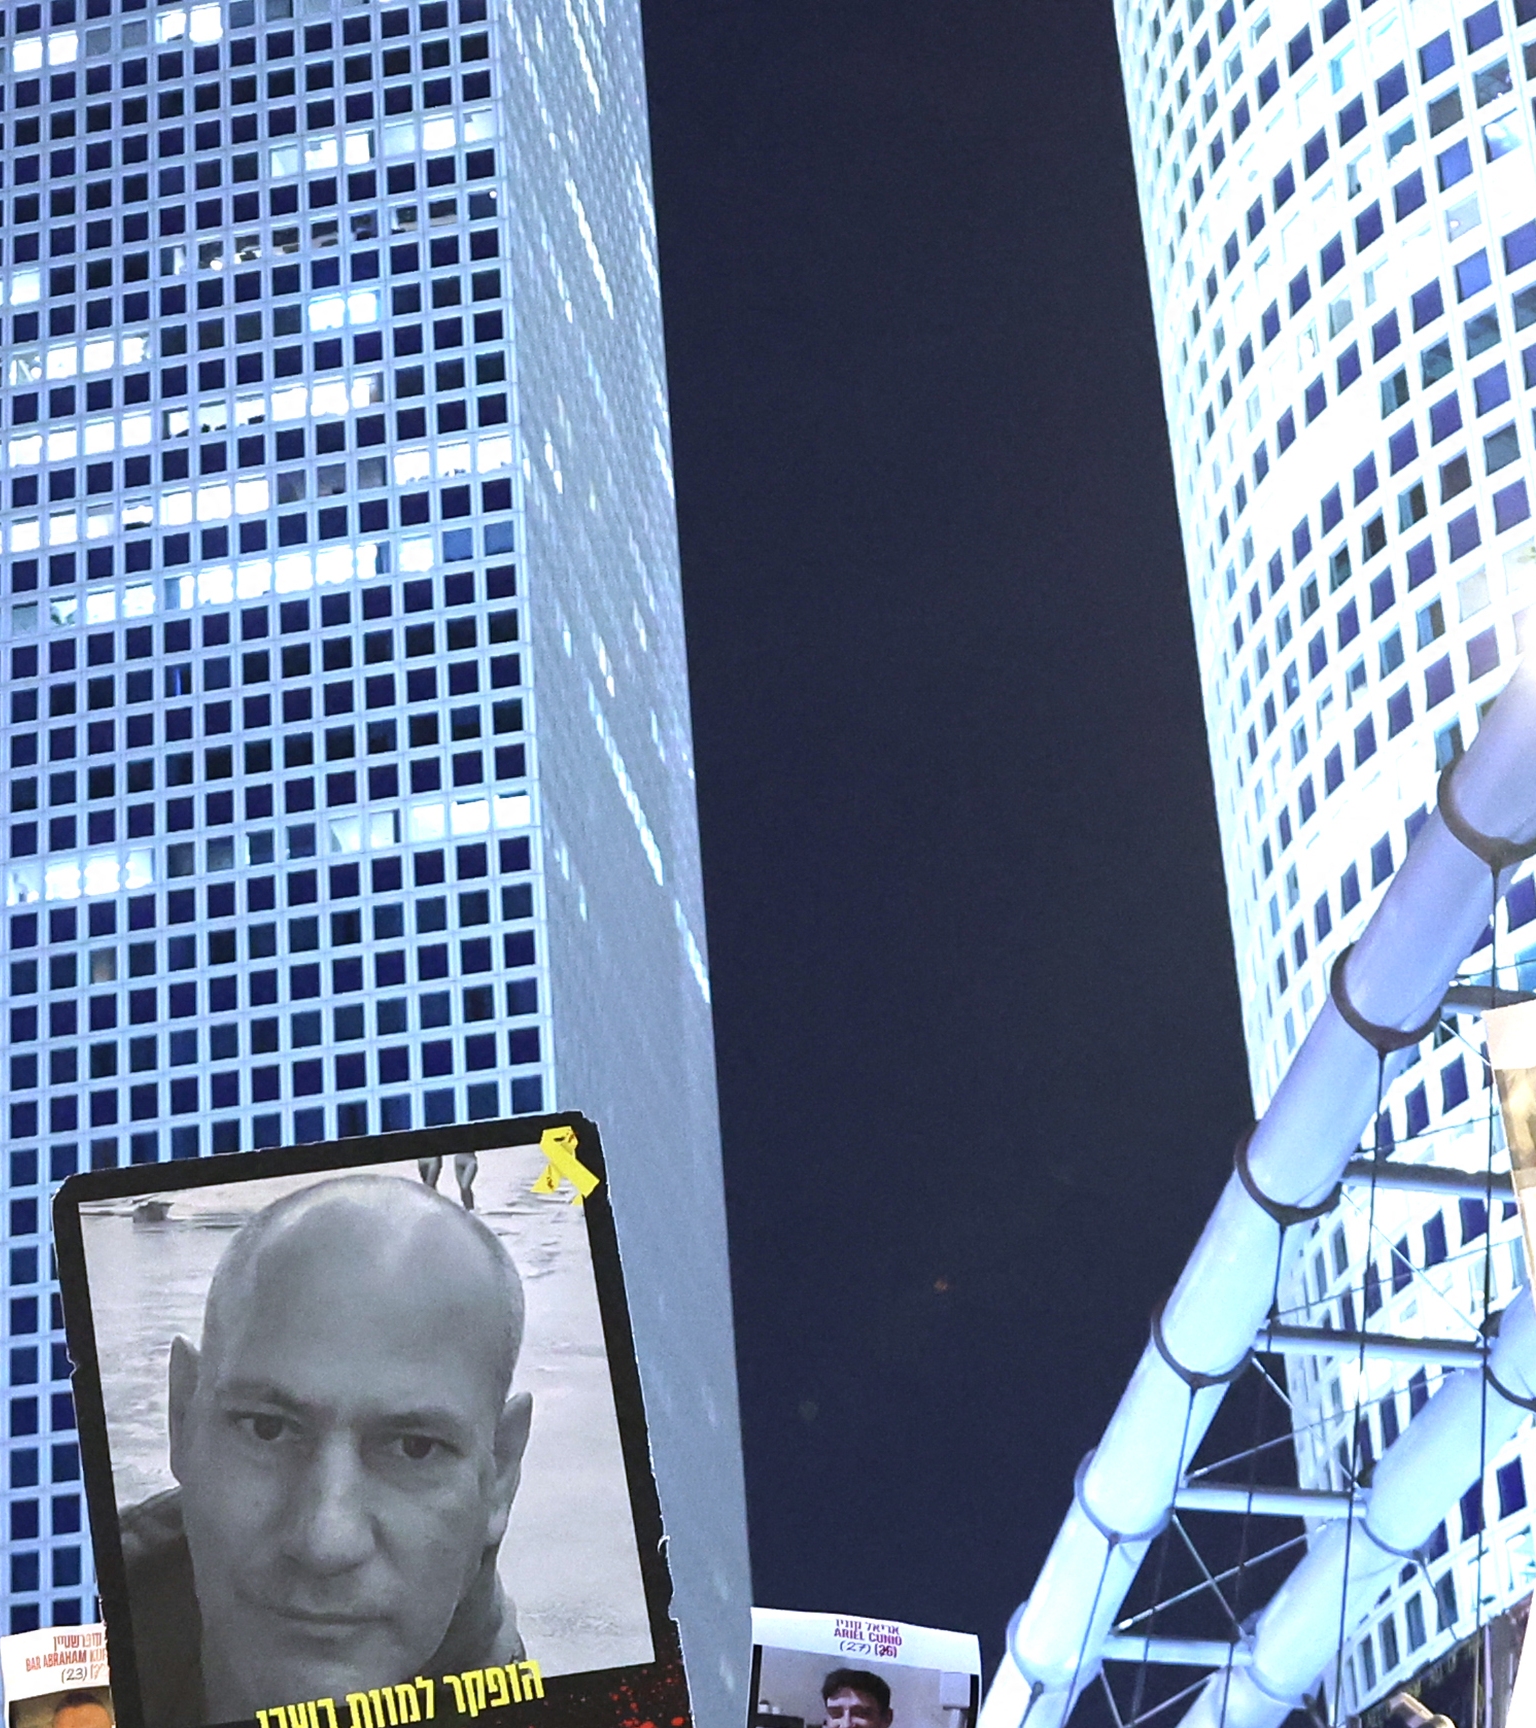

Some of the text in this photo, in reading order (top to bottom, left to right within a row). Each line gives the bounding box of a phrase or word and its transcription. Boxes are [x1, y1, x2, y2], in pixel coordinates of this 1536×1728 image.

[833, 1628, 903, 1647] ARIEL CUNIO
[865, 1621, 901, 1636] אריאל
[839, 1640, 871, 1655] (27)
[25, 1655, 42, 1673] BAR
[43, 1649, 88, 1668] ABRAHAM
[61, 1666, 88, 1684] (23)
[443, 1659, 546, 1718] הופקר
